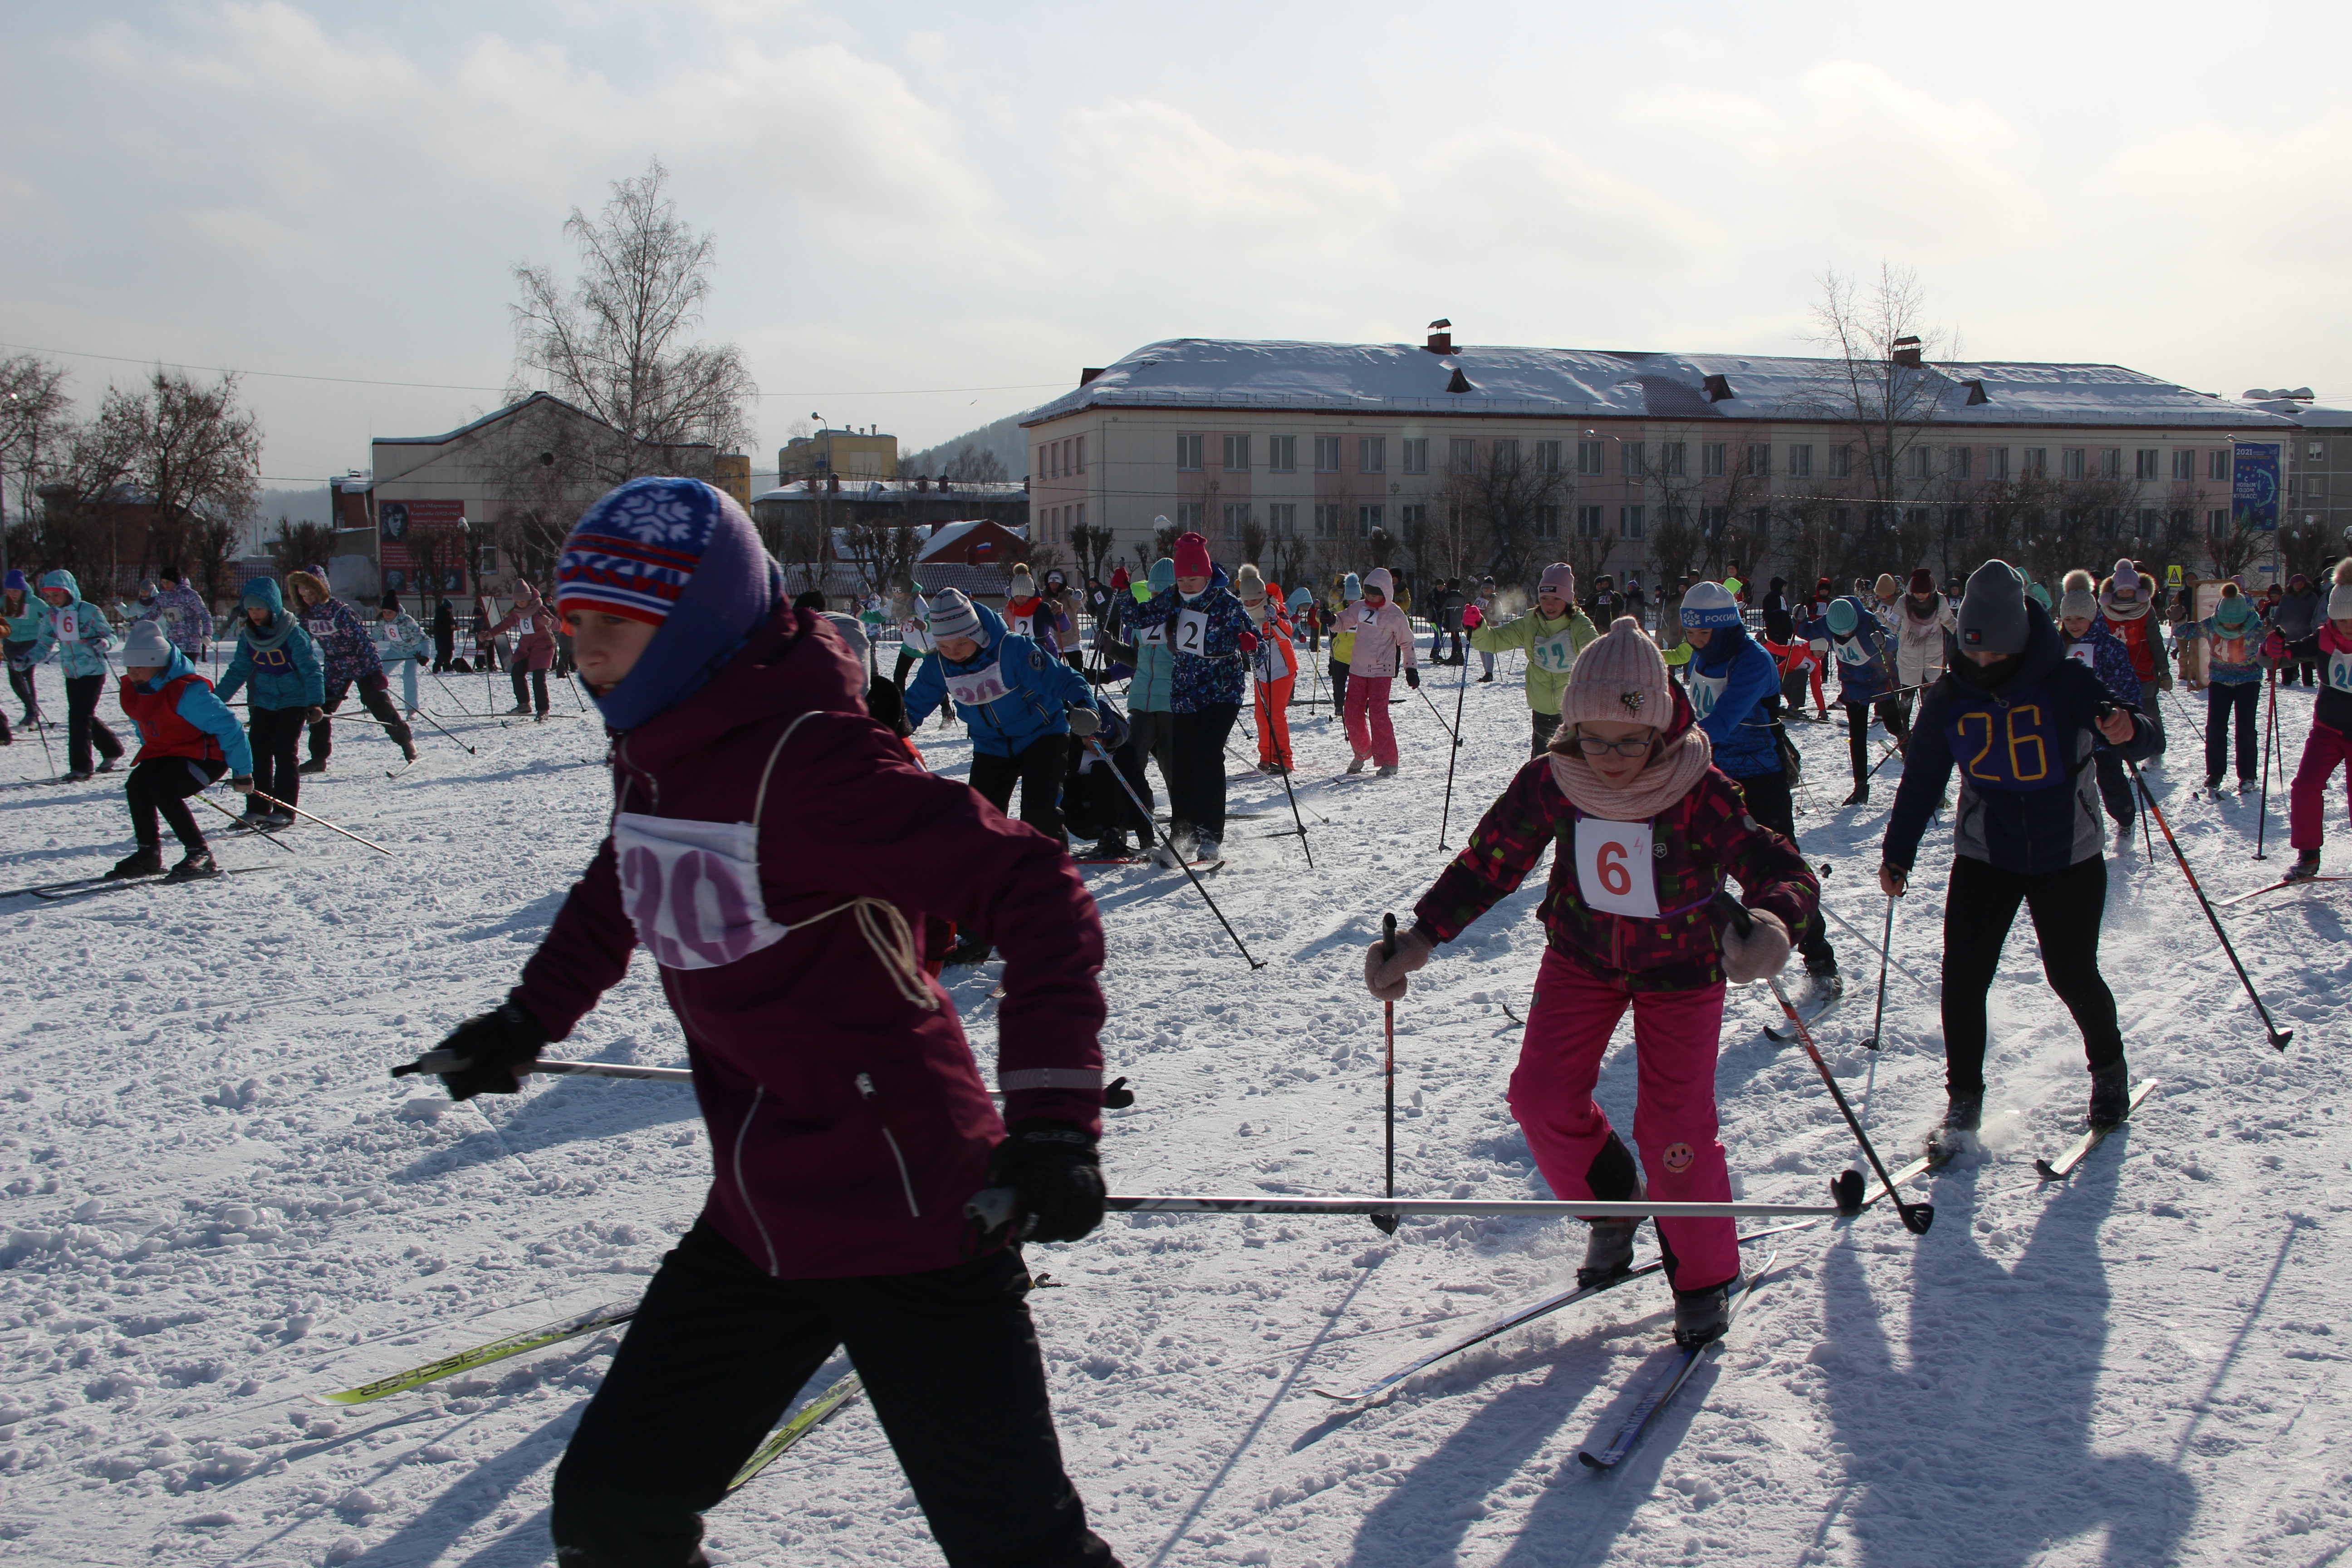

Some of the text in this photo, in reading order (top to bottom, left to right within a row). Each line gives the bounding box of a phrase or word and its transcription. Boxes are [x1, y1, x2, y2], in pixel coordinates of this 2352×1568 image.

[1952, 599, 1958, 608] 2
[63, 616, 74, 633] 6
[523, 618, 529, 629] 6
[1363, 609, 1375, 625] 2
[1705, 612, 1737, 623] РОССИИ
[389, 628, 397, 637] 6
[1019, 620, 1029, 636] 2
[1182, 621, 1198, 650] 2
[1838, 646, 1860, 662] 24
[2214, 638, 2230, 662] 4
[1957, 704, 2048, 781] 26
[1596, 841, 1632, 896] 6
[623, 845, 754, 969] 20
[1620, 1392, 1665, 1434] NORDWAY
